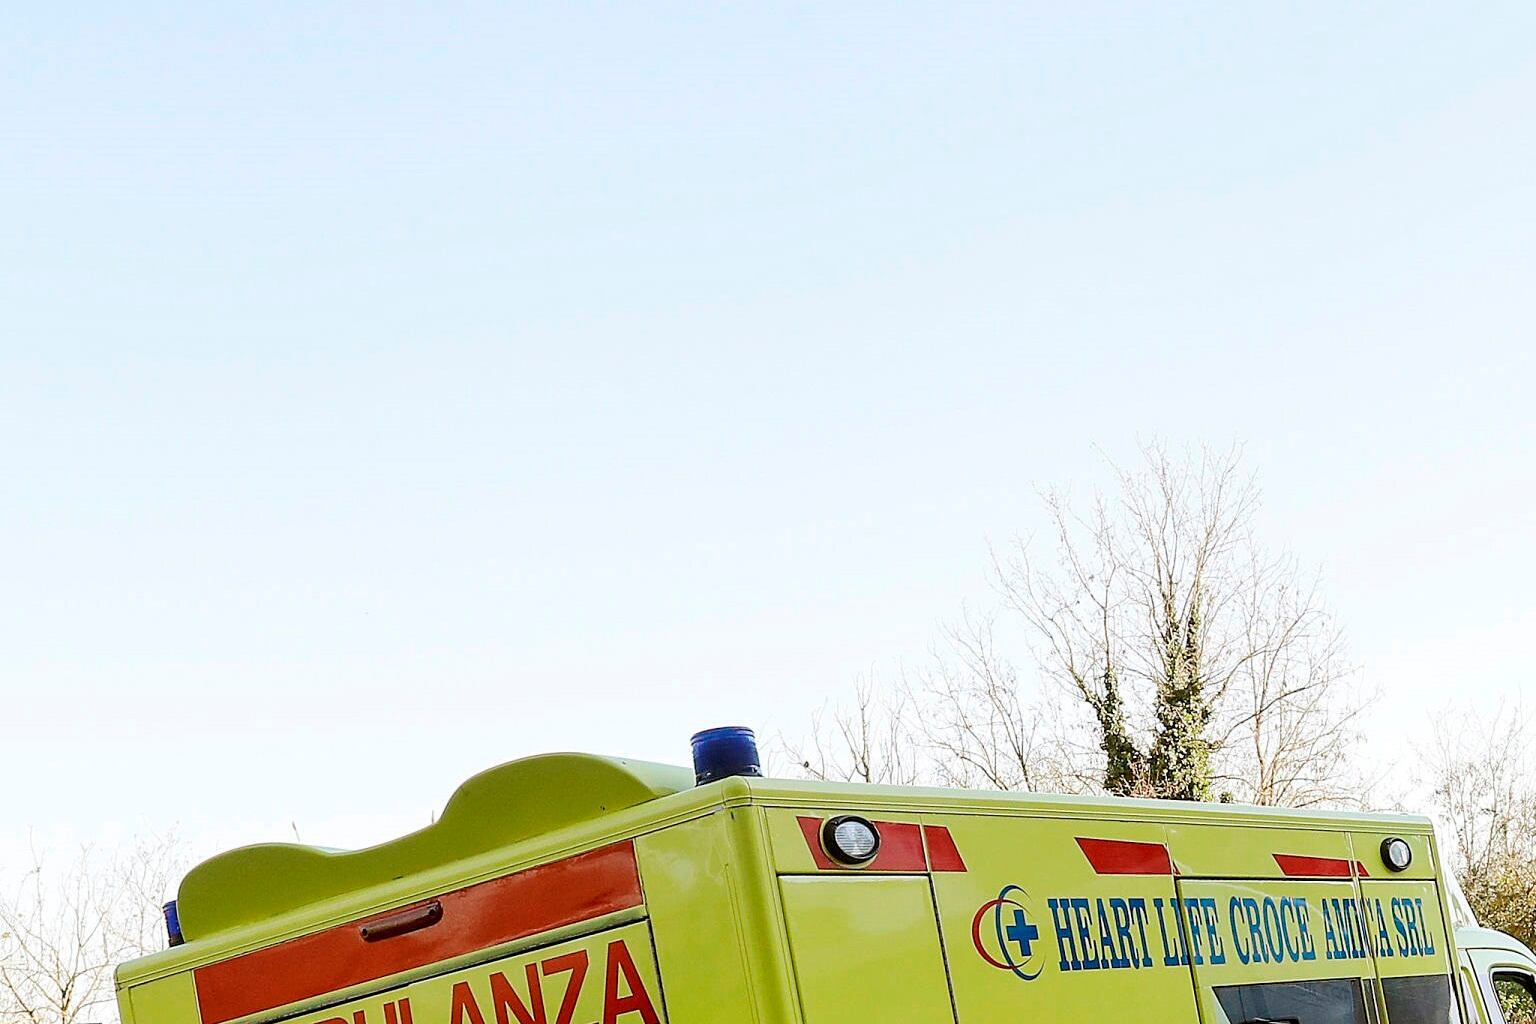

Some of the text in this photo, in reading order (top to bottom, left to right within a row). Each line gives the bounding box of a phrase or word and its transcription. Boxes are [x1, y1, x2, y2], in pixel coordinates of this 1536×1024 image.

[1047, 898, 1153, 971] HEART
[1153, 897, 1226, 967] LIFE
[1229, 896, 1316, 965] CROCE
[1391, 897, 1435, 958] SRL
